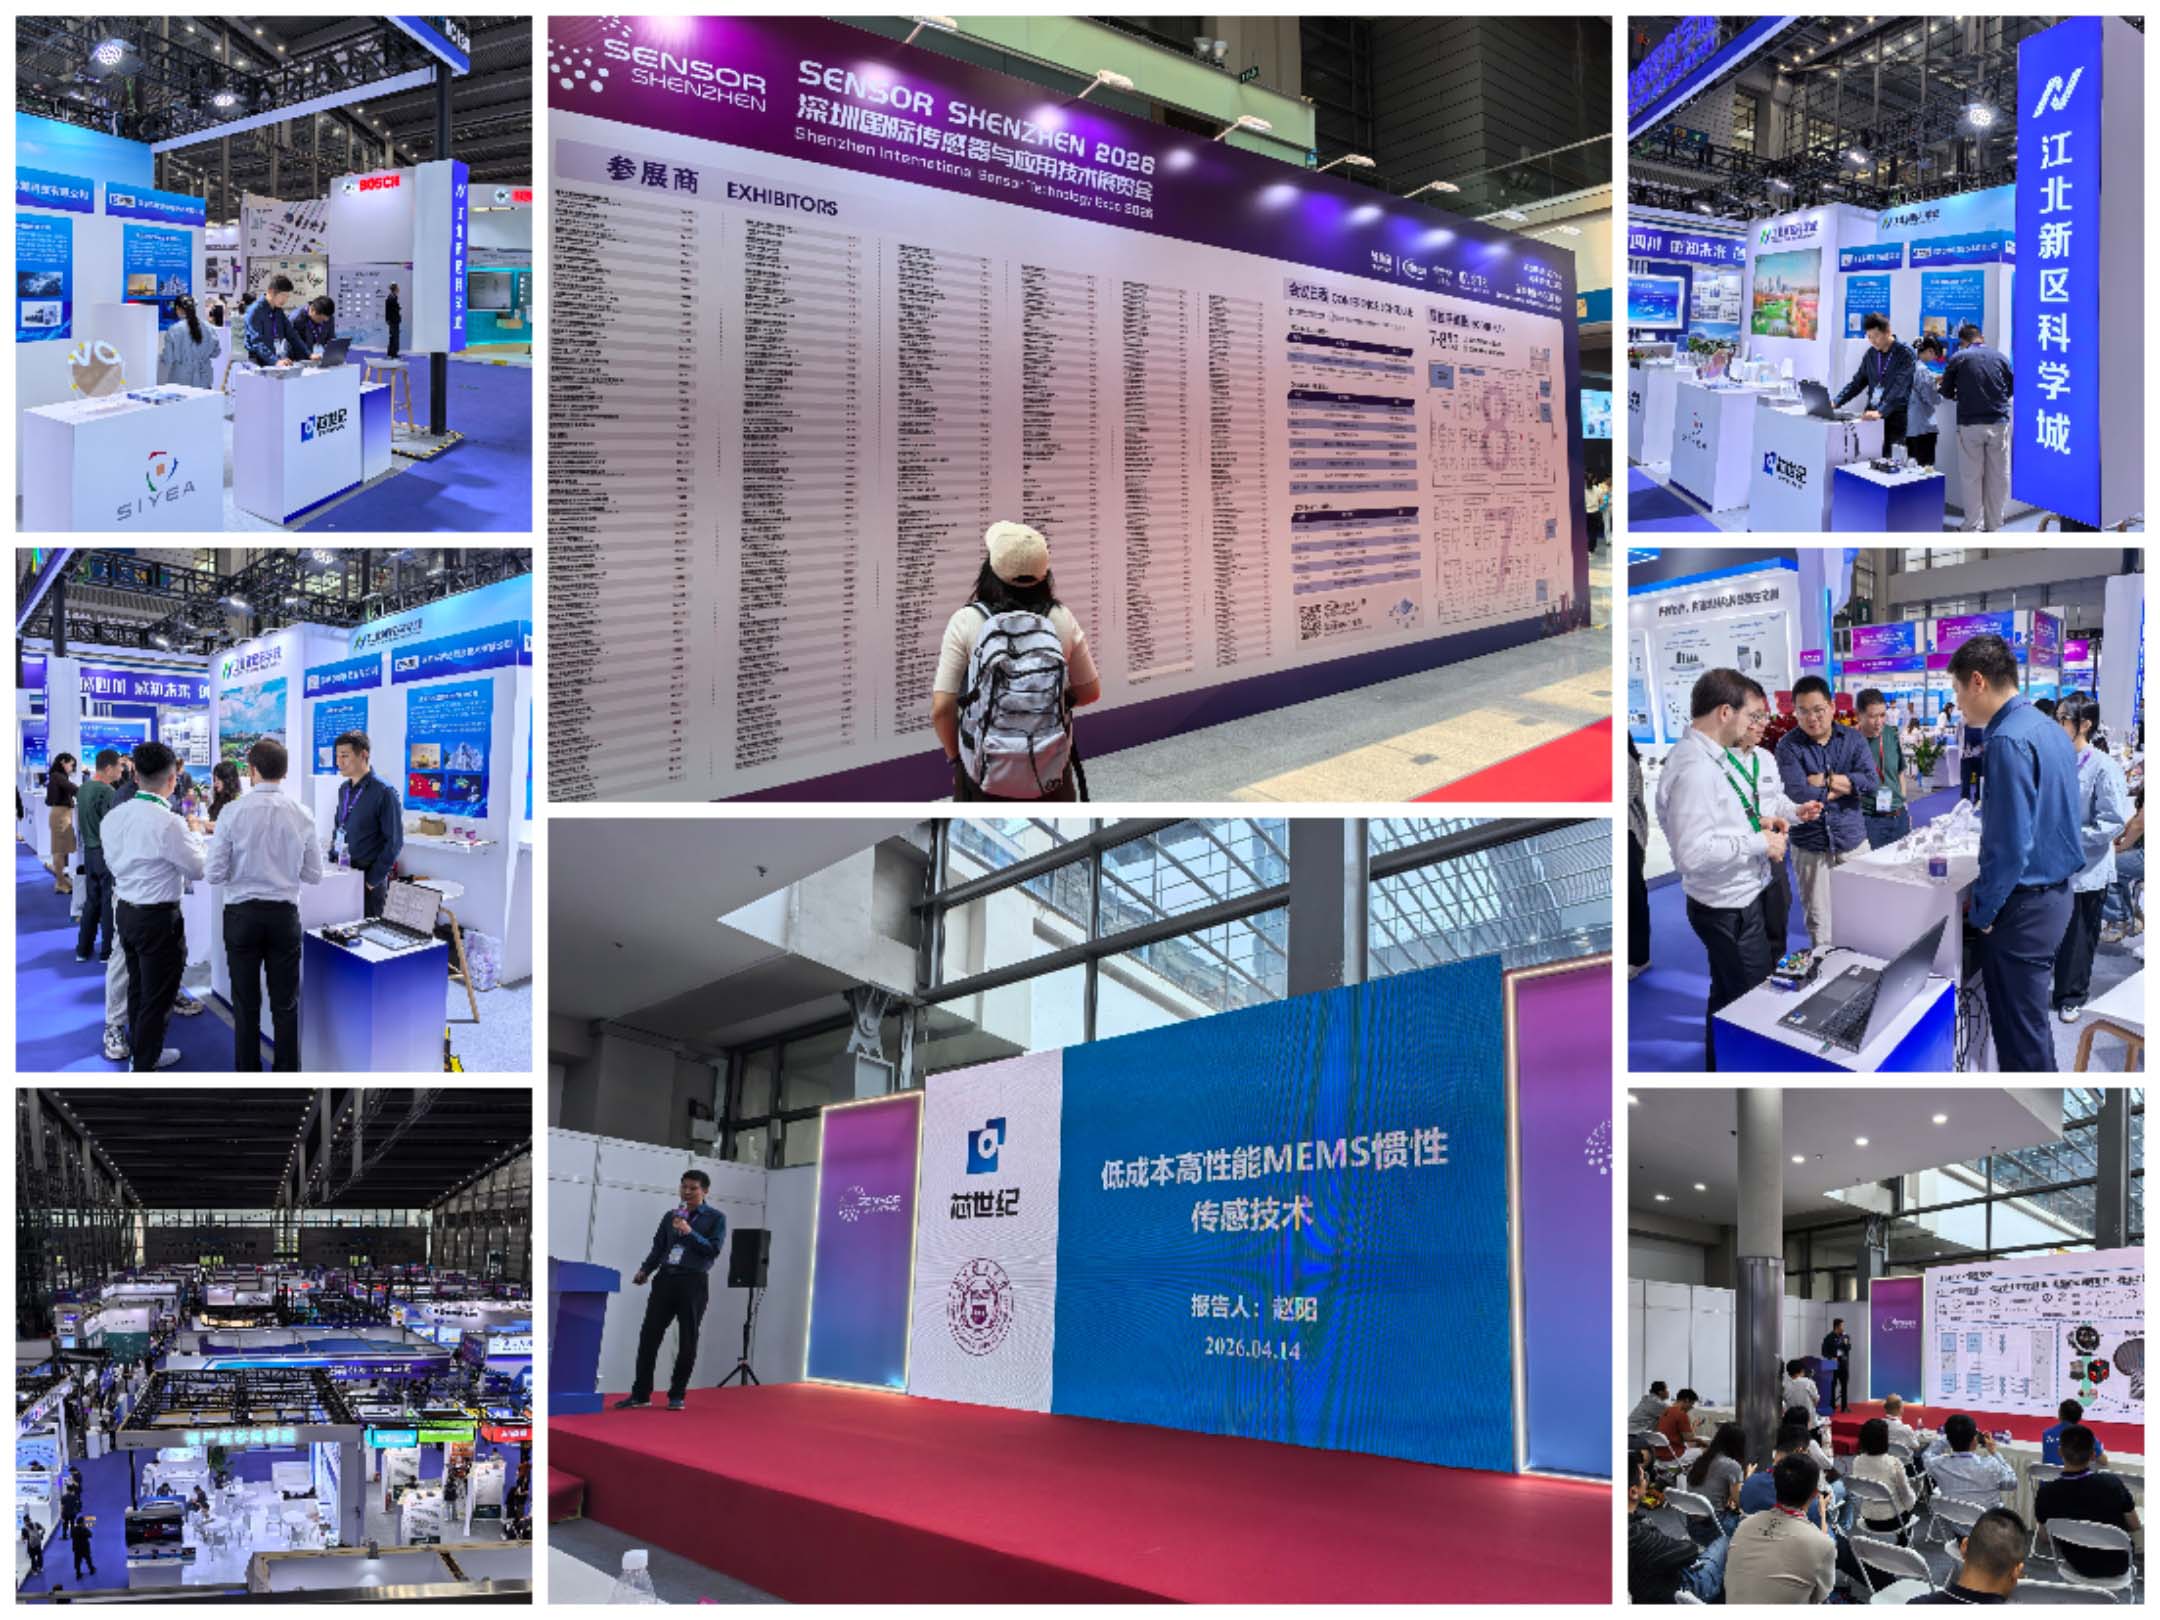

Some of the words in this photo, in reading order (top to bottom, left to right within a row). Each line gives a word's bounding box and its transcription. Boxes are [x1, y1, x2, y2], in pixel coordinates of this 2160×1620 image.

[604, 38, 766, 94] SENSOR
[632, 67, 766, 112] SHENZHEN
[798, 60, 934, 116] SENSOR
[948, 101, 1085, 157] SHENZHEN
[1095, 142, 1155, 174] 2026
[794, 127, 875, 157] Shenzhen
[606, 154, 699, 194] 参展商
[727, 181, 839, 216] EXHIBITORS
[2036, 131, 2073, 456] 江北新区科学城
[1100, 1126, 1449, 1190] 低成本高性能MEMS惯性
[950, 1187, 1020, 1219] 芯世纪
[1191, 1194, 1314, 1234] 传感技术
[1204, 1336, 1300, 1361] 2026.04.14
